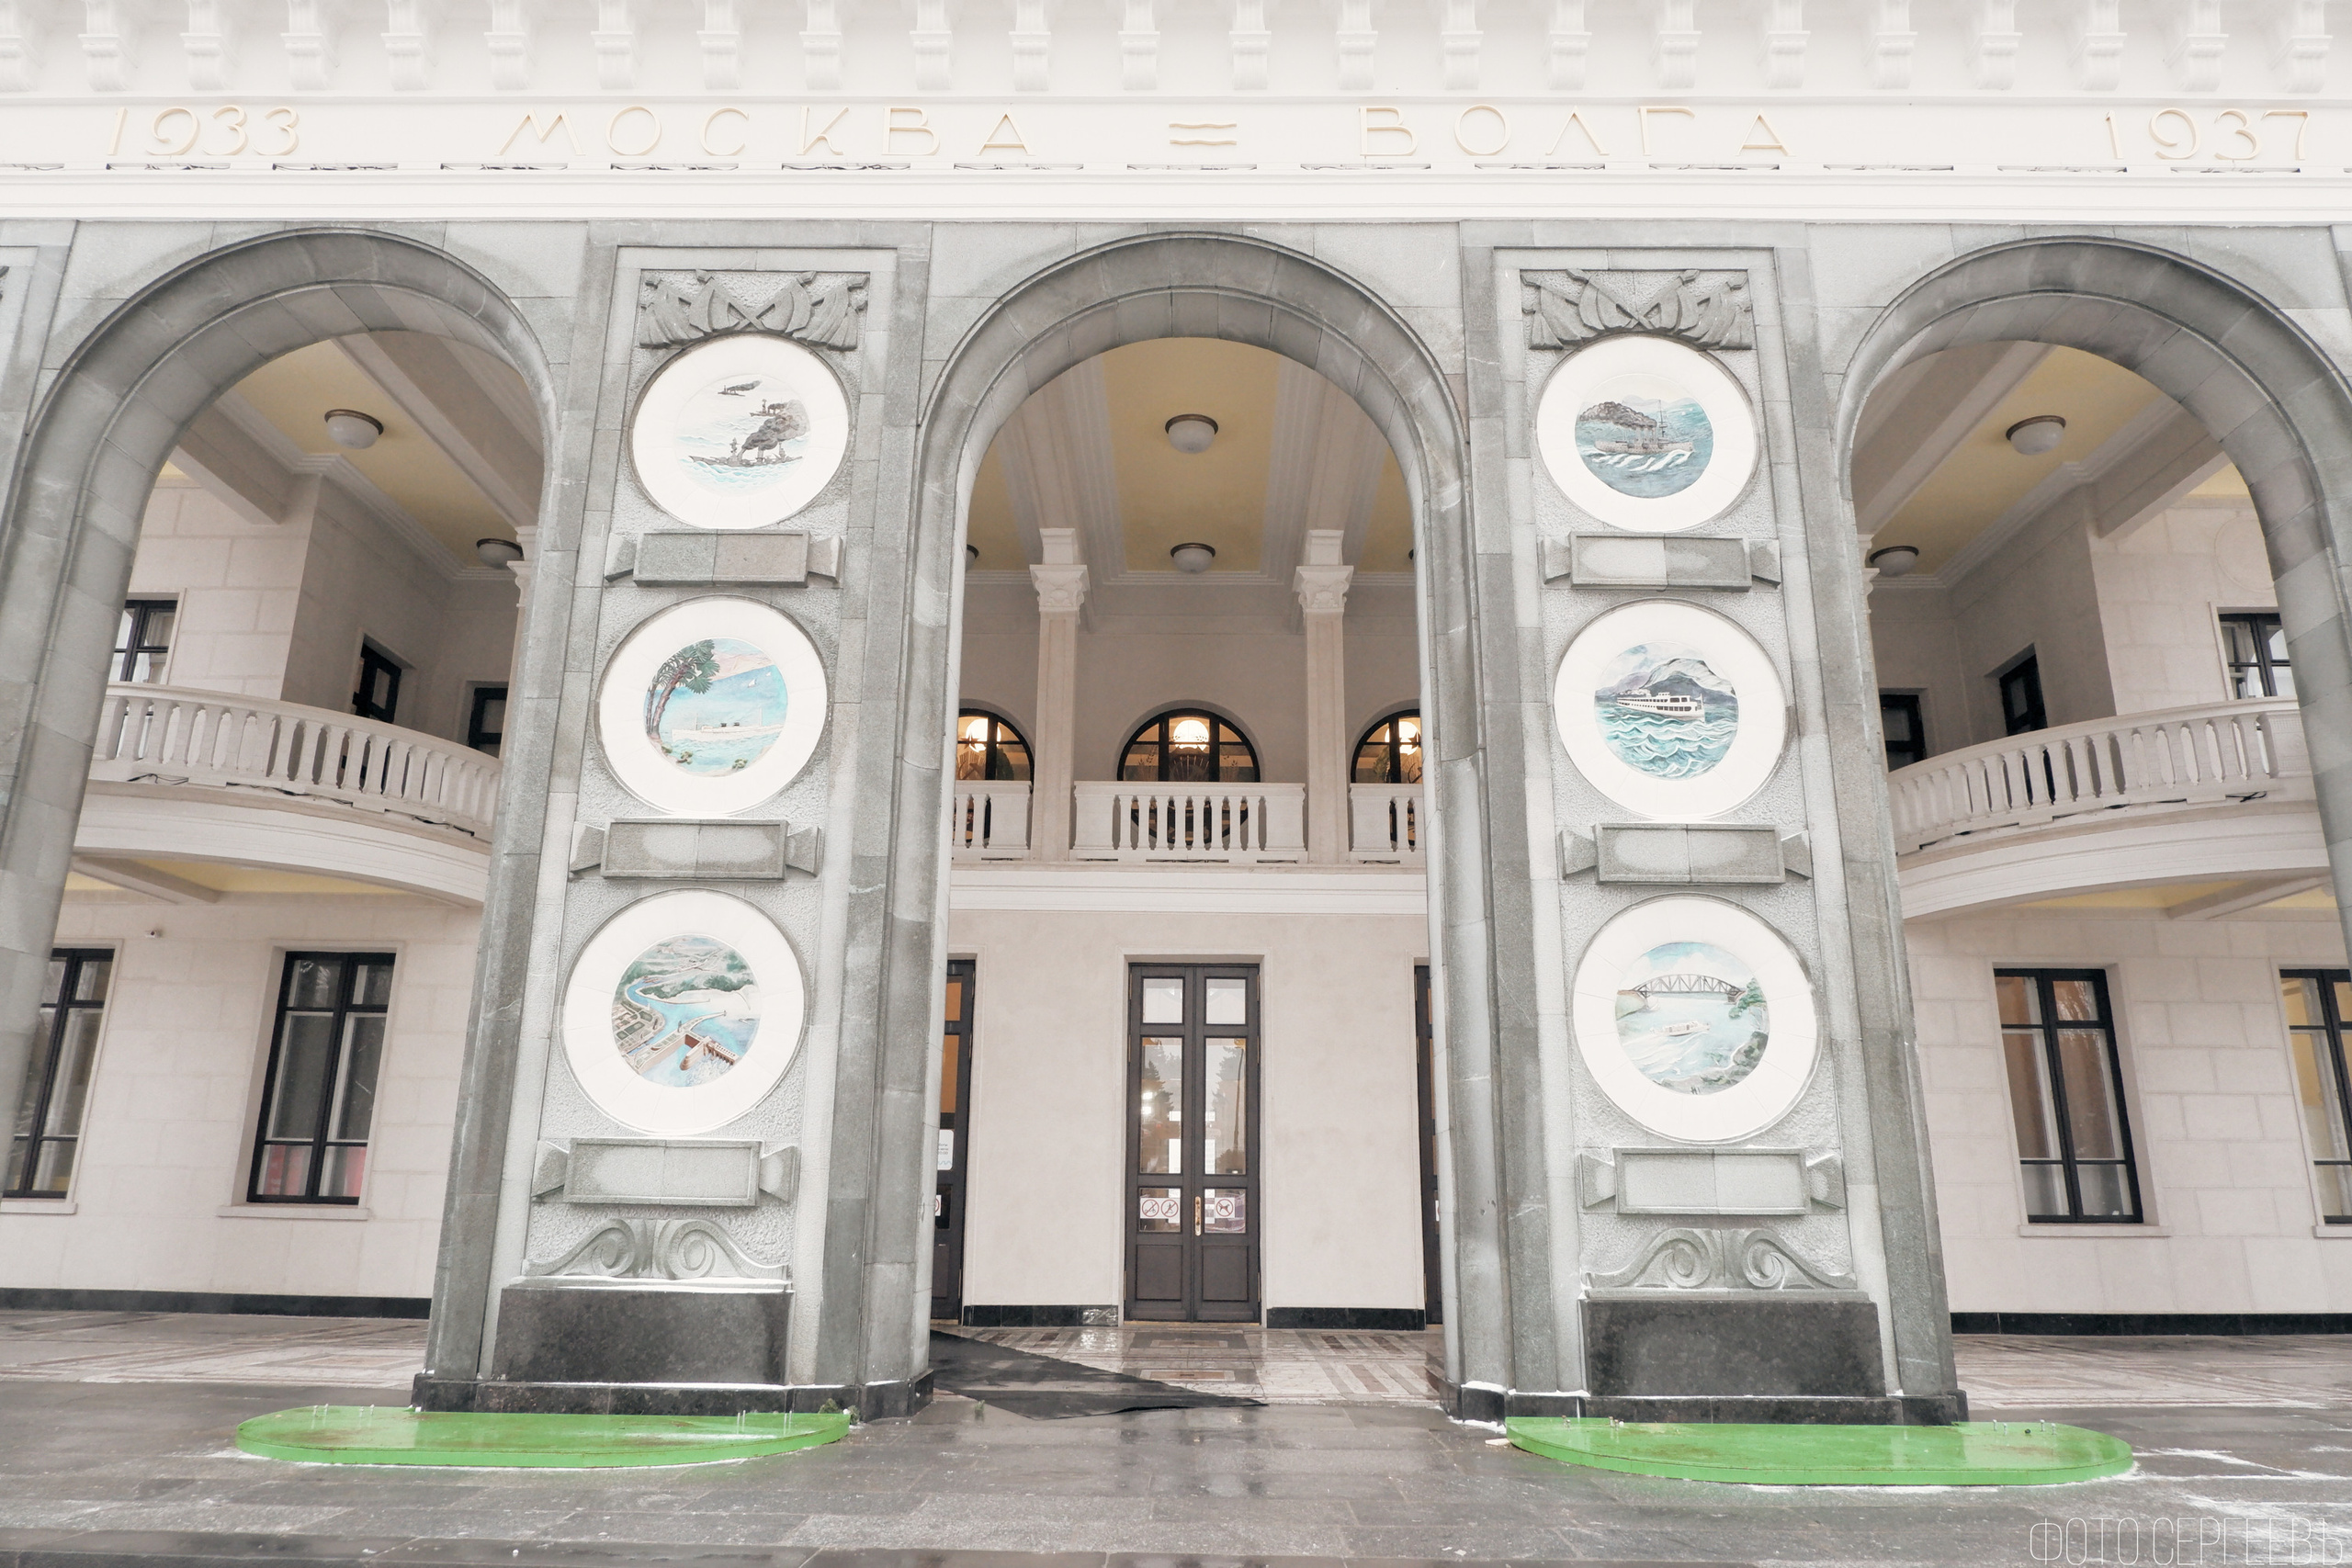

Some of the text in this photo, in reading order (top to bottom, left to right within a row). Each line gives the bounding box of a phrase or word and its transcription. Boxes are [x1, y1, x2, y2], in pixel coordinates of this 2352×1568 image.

[107, 103, 2310, 160] 1933 МОСКВА ВОЛГА 1937
